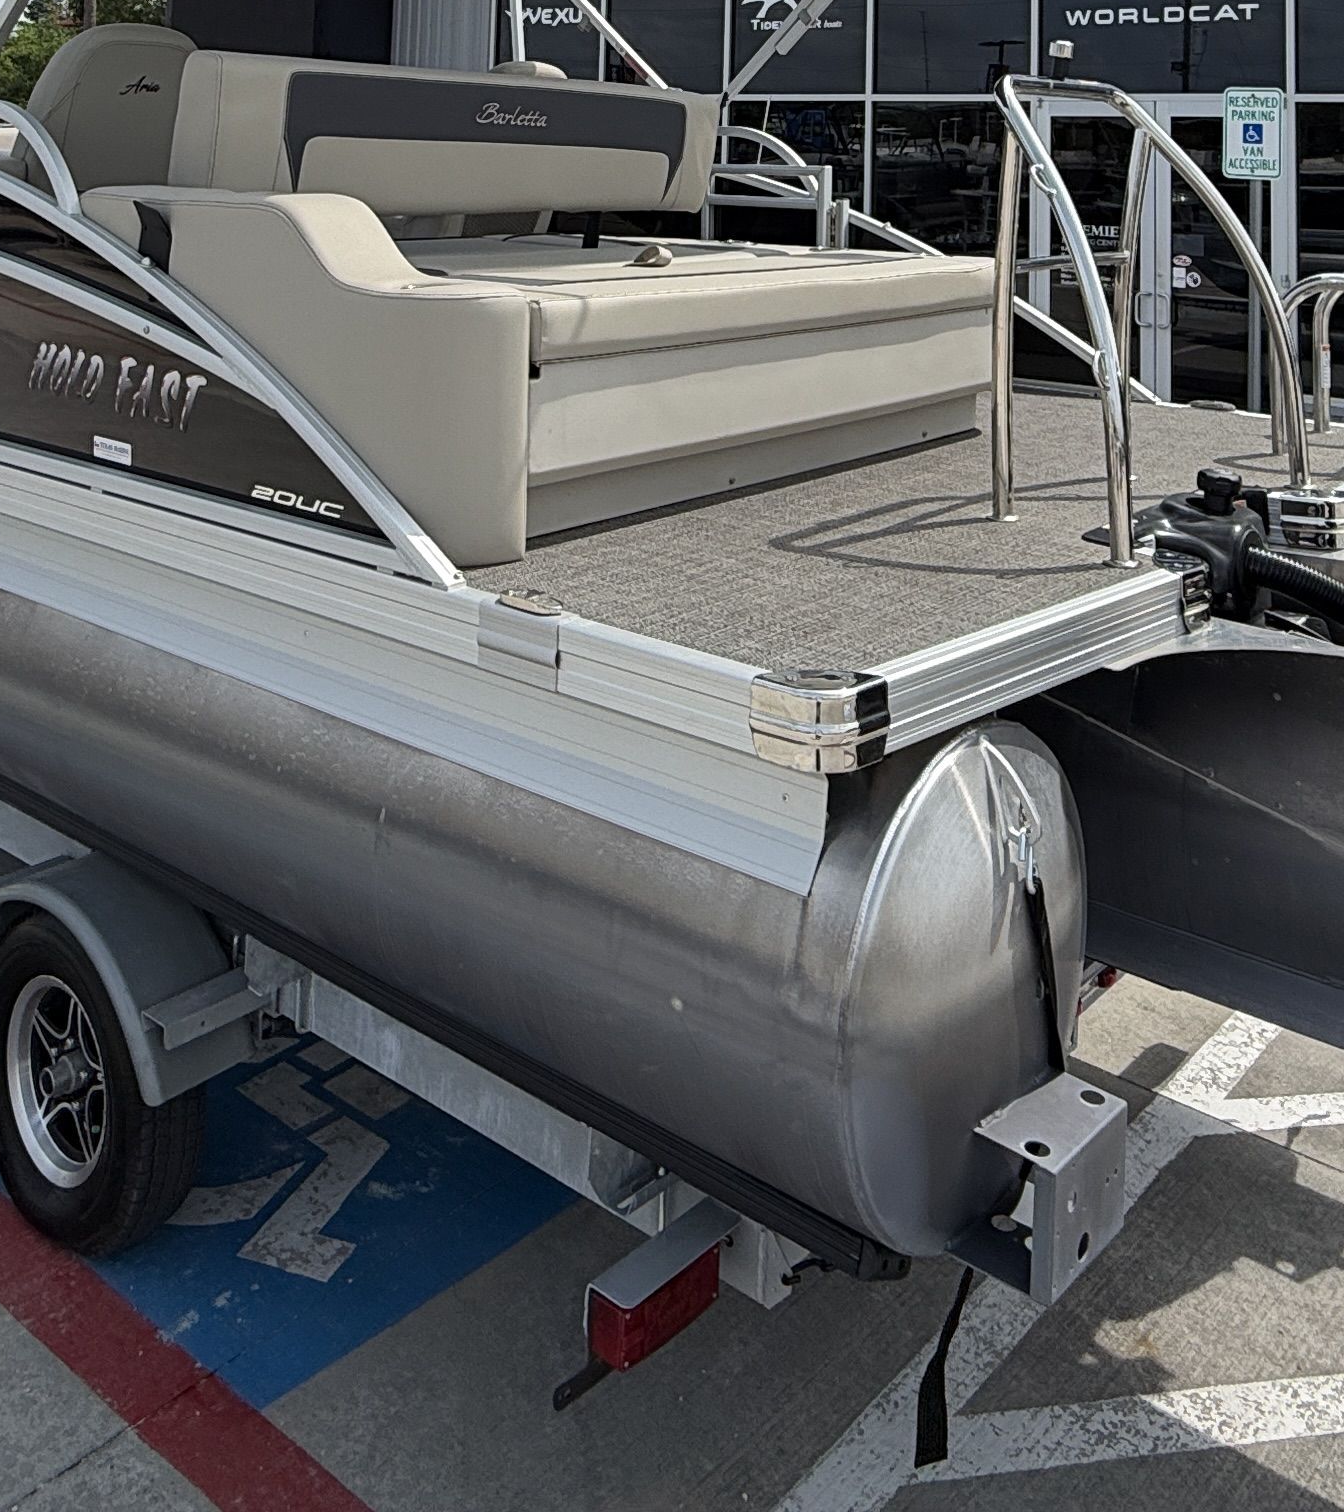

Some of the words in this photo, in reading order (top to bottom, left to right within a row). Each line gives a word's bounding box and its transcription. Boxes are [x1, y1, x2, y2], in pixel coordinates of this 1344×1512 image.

[526, 7, 583, 26] VEXU
[1065, 3, 1259, 26] WORLDCAT
[751, 19, 821, 30] TIDER
[1228, 96, 1278, 108] RESERVED
[476, 102, 547, 127] Barletta
[1231, 109, 1275, 122] PARKING
[1242, 146, 1263, 157] VAN
[1228, 158, 1277, 171] ACCESSIBLE
[1083, 225, 1121, 238] EMIE
[28, 342, 104, 400] HOLD
[114, 356, 208, 432] FAST
[251, 484, 344, 519] 20UC
